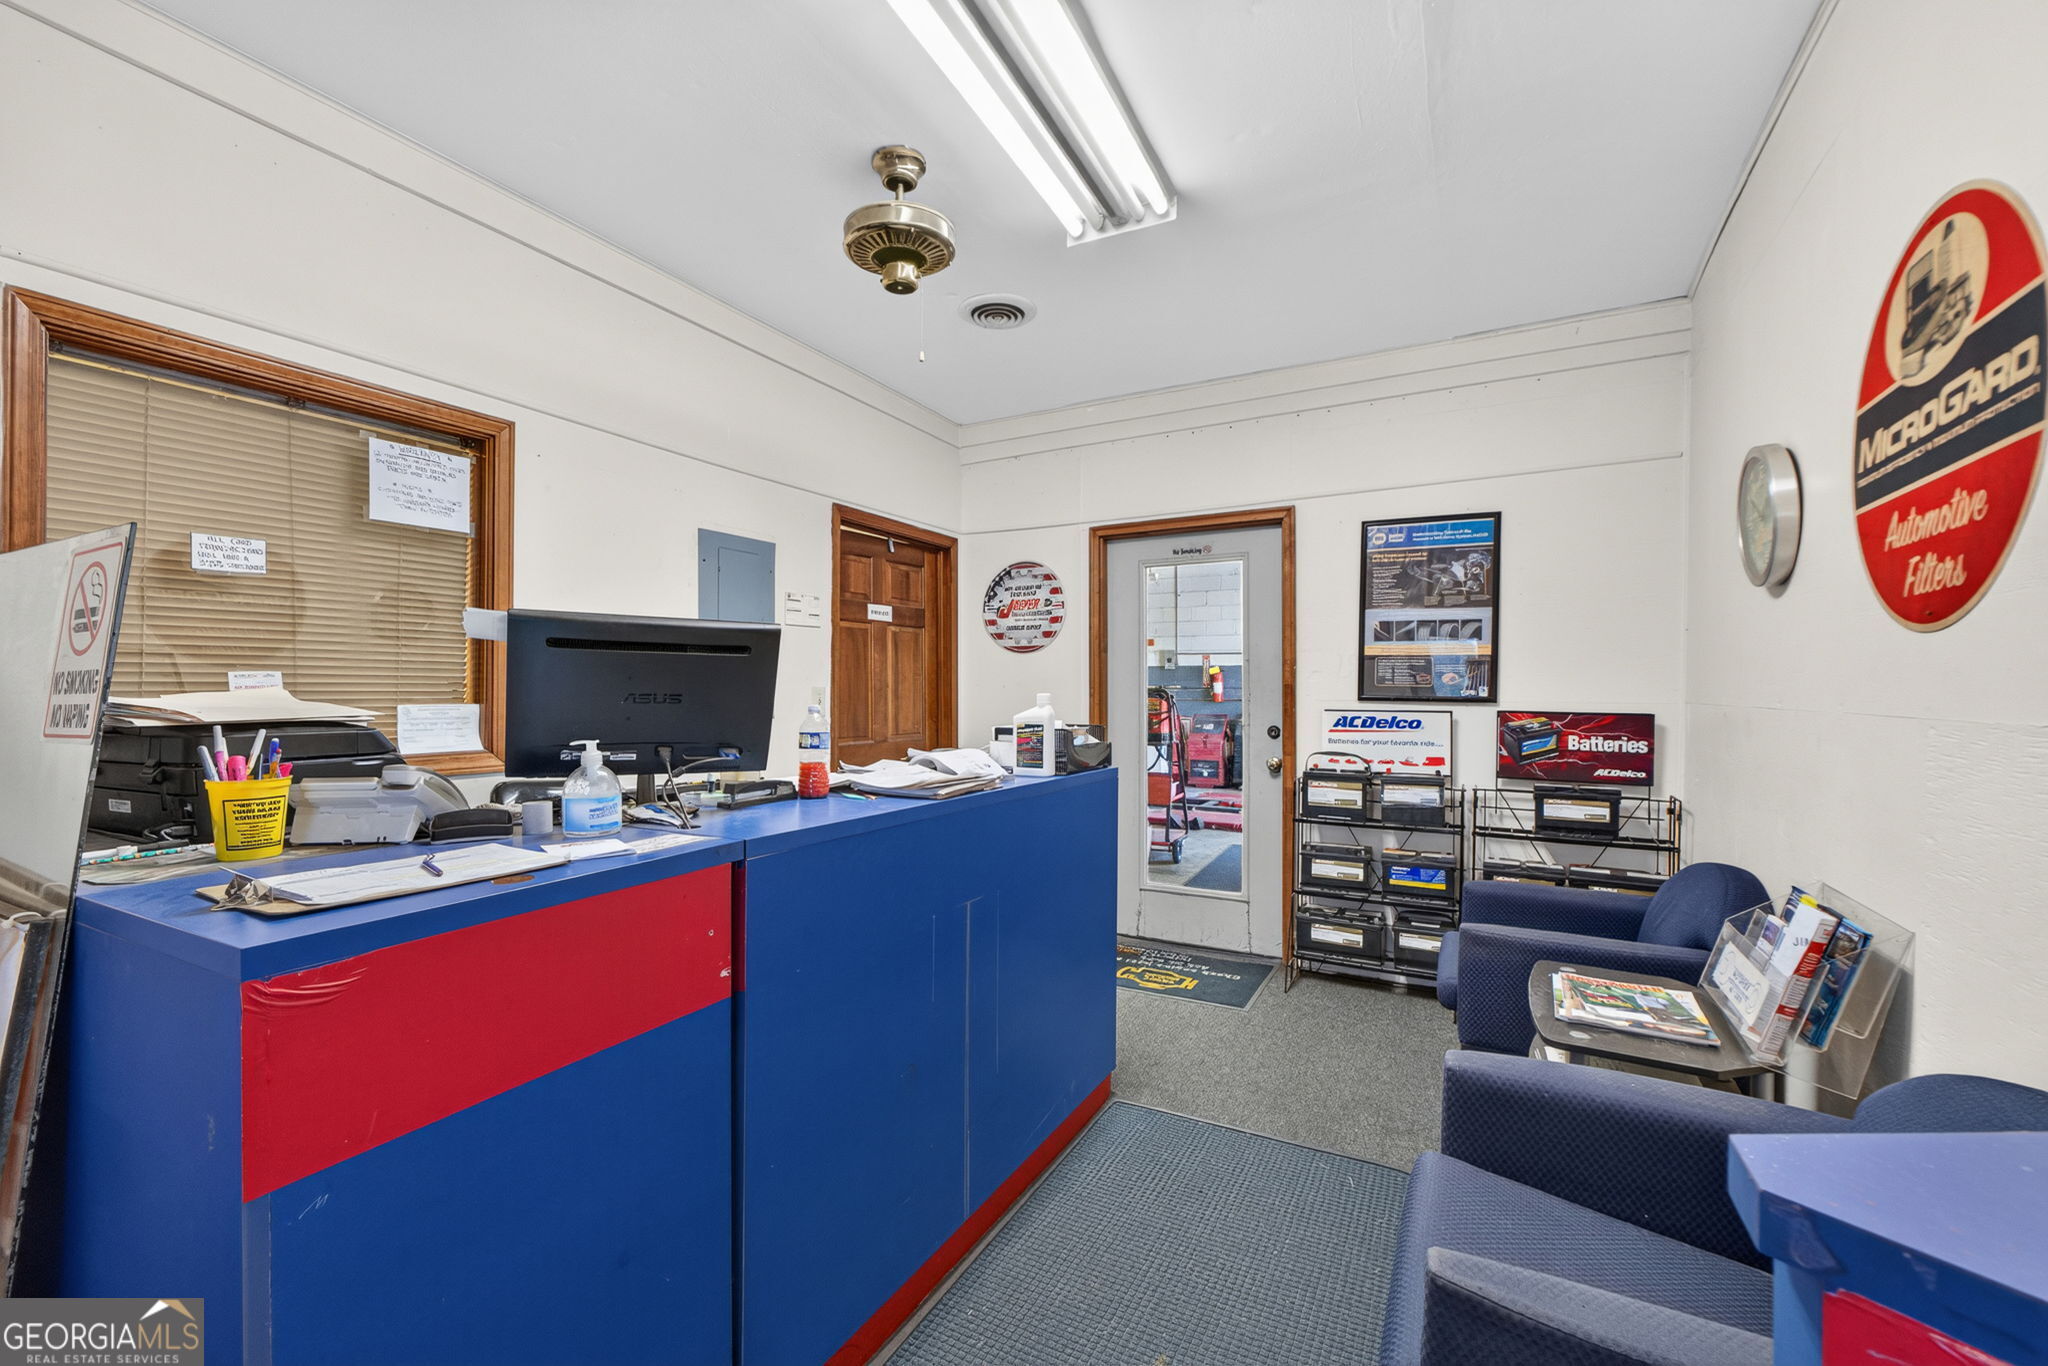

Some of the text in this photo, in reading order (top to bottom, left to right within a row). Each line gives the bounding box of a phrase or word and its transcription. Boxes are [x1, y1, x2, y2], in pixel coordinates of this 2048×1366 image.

[1884, 487, 1989, 552] Automotive
[1903, 552, 1967, 597] Filters
[64, 669, 99, 695] SMOKING
[623, 693, 683, 704] ASUS
[63, 703, 90, 729] VAPING
[1333, 715, 1423, 730] ACDelco
[1372, 739, 1389, 747] your
[1568, 735, 1649, 753] Batteries
[1593, 768, 1648, 778] ACDelco
